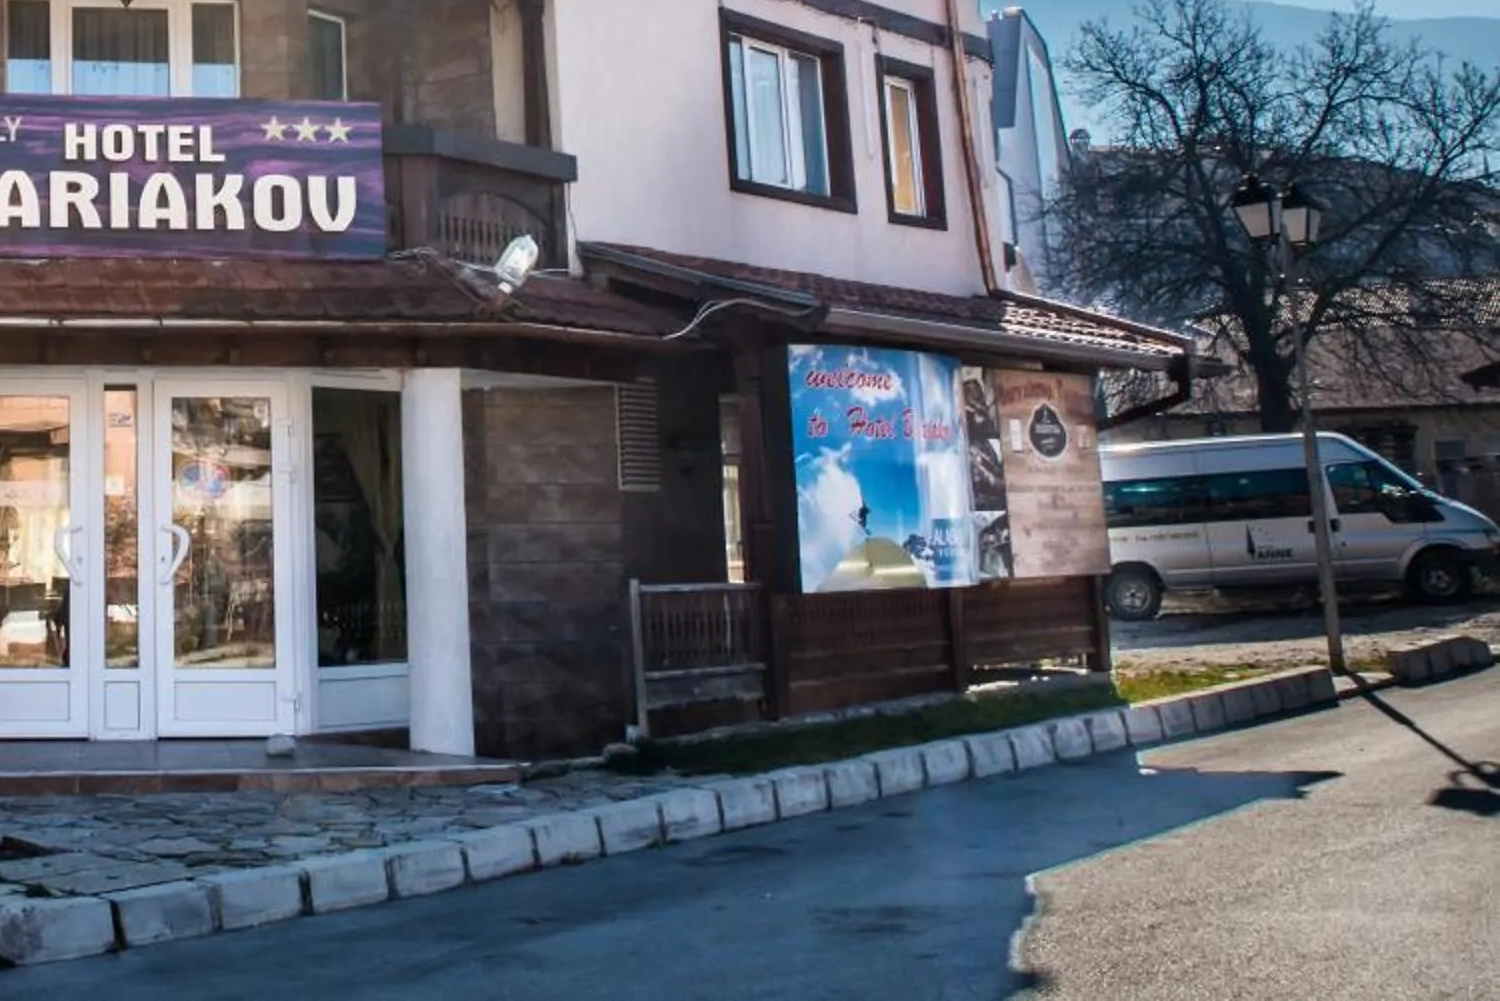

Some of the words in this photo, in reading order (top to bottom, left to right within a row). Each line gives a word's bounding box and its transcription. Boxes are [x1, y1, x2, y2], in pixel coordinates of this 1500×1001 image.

[64, 123, 226, 162] HOTEL
[805, 369, 894, 391] welcome
[807, 413, 829, 440] to
[845, 406, 897, 440] Hotel
